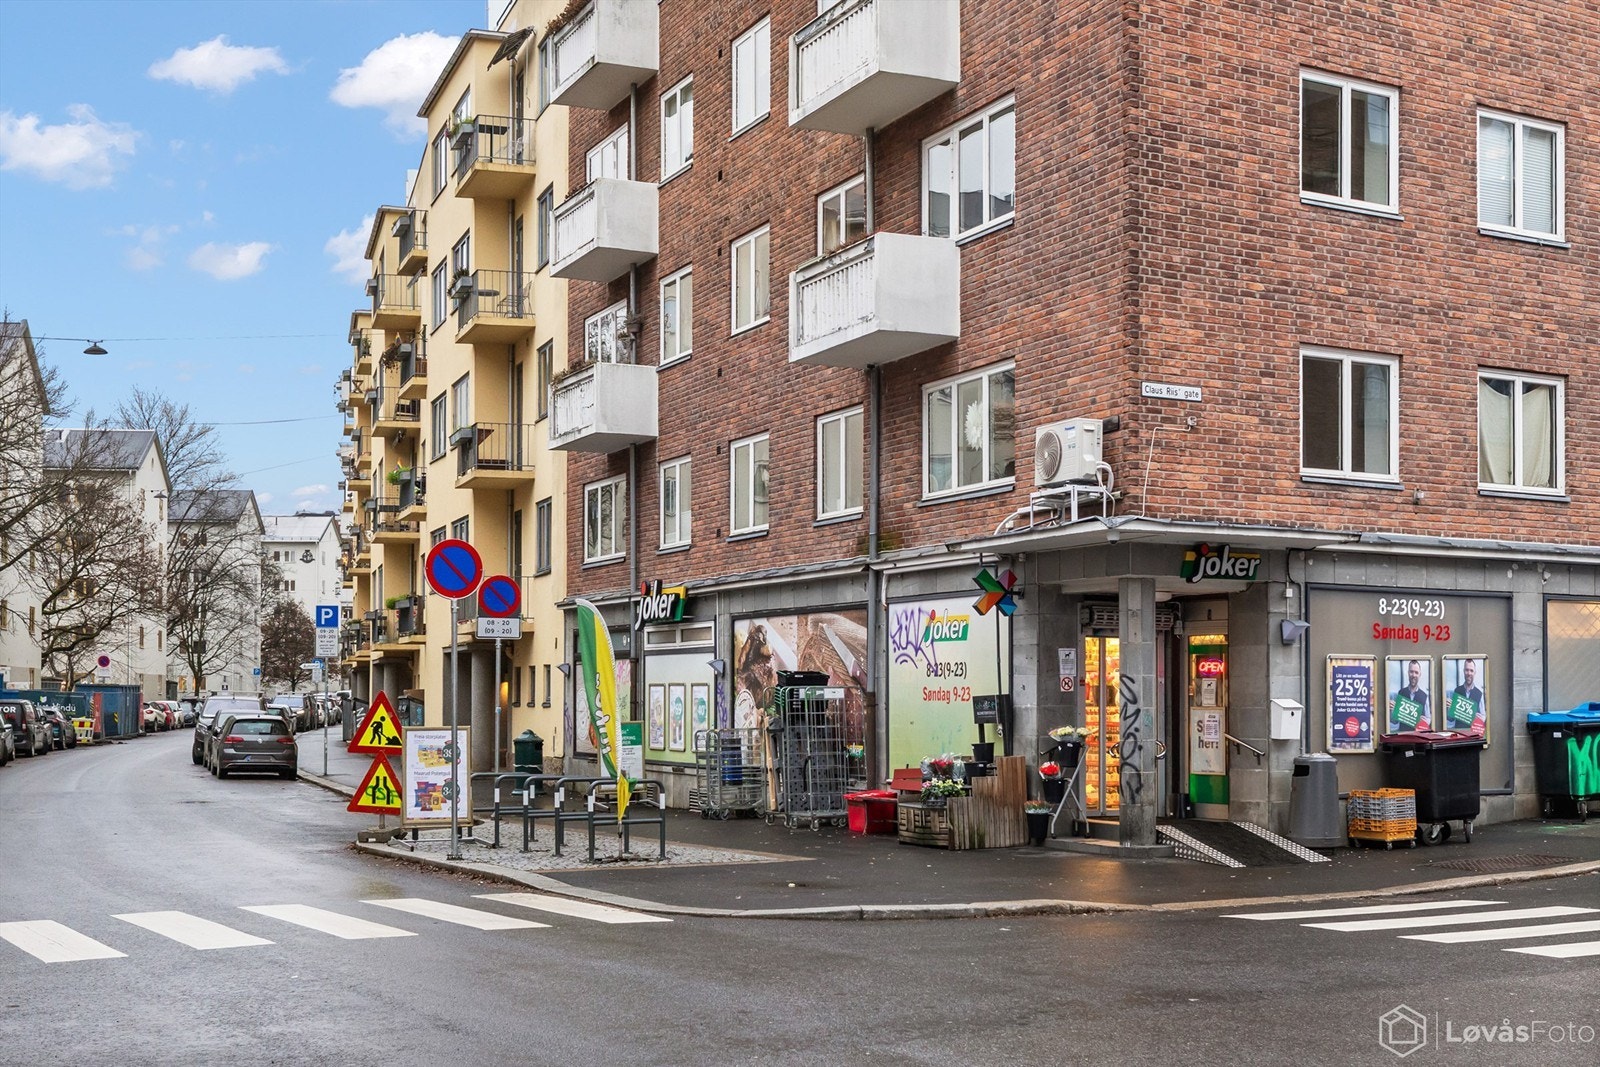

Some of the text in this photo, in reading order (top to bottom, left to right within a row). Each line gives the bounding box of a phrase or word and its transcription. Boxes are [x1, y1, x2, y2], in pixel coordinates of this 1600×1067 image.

[1144, 385, 1163, 395] Claus
[1184, 390, 1199, 399] gate
[1192, 543, 1260, 583] joker
[634, 580, 675, 630] joker
[1378, 598, 1444, 620] 8-23(9-23)
[321, 608, 334, 624] P
[926, 608, 966, 648] joker
[1372, 622, 1451, 643] Søndag 9-23
[1199, 662, 1224, 672] OPEN
[922, 686, 971, 704] Søndag 9-23
[1336, 679, 1368, 696] 25%
[1399, 701, 1418, 718] 25%
[1456, 698, 1473, 715] 25%
